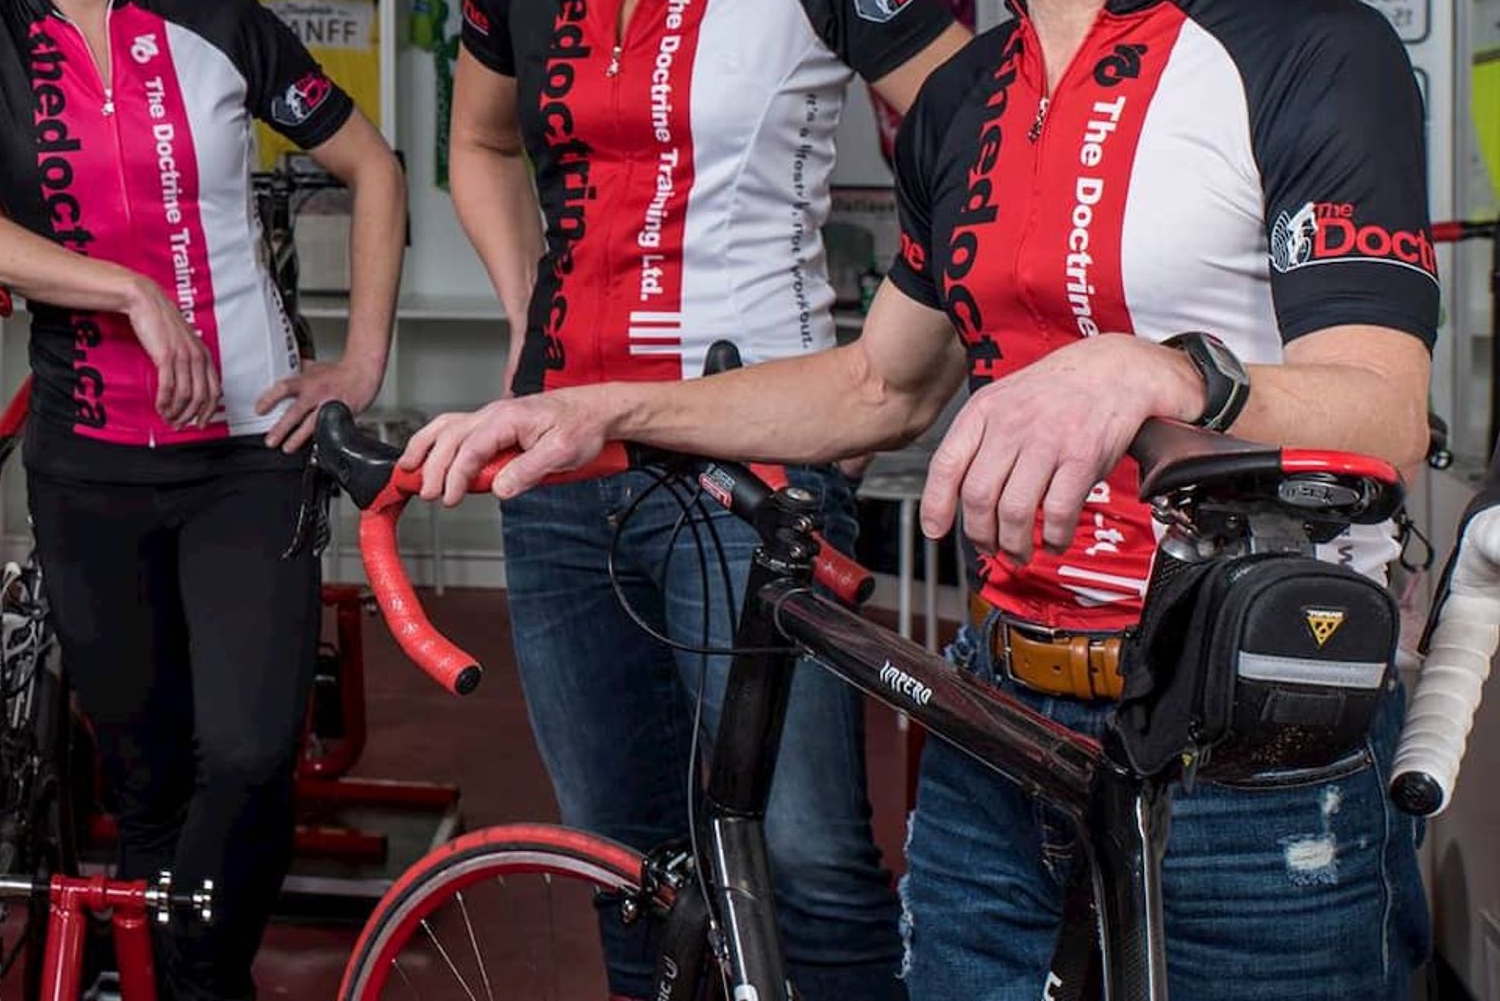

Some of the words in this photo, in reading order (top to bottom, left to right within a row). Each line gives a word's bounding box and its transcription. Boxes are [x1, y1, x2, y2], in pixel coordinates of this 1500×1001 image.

[288, 18, 357, 42] ANFF
[144, 76, 164, 118] The
[650, 35, 682, 143] Doctrine
[1080, 96, 1126, 168] The
[152, 123, 183, 225] Doctrine
[637, 149, 679, 248] Training
[639, 255, 664, 301] Ltd.
[1065, 177, 1104, 340] Doctrine
[880, 659, 933, 706] IMPERO
